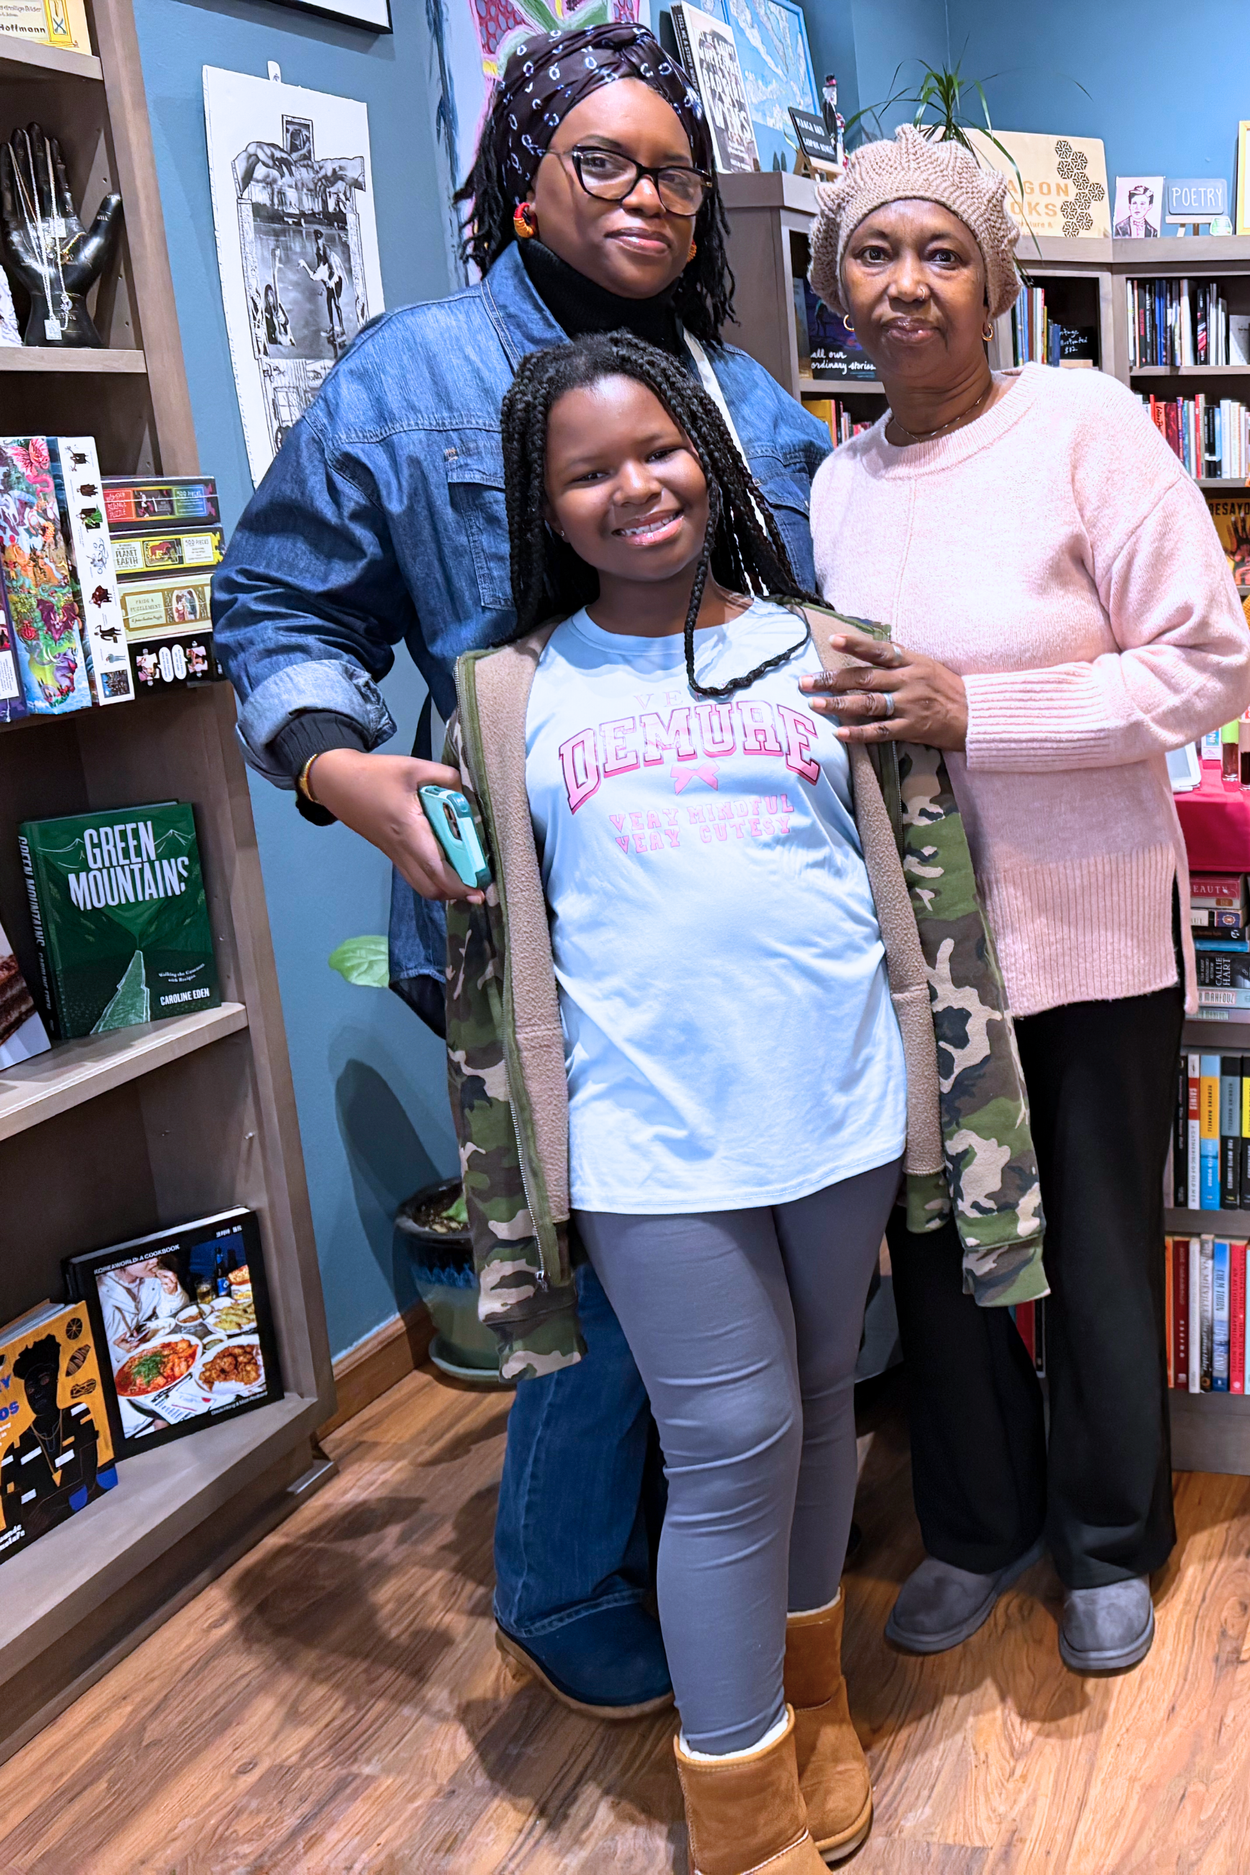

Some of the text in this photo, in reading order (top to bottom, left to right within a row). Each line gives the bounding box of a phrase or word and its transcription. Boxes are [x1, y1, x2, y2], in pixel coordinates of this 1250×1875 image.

[1007, 179, 1069, 197] AGON
[1172, 186, 1223, 207] POETRY
[1010, 201, 1057, 217] OKS
[559, 700, 822, 814] DEMURE
[609, 794, 794, 832] VERY MINDFUL
[83, 821, 156, 869] GREEN
[615, 816, 791, 854] VERY CUTESY
[68, 856, 190, 911] MOUNTAINS
[1222, 958, 1231, 986] HART
[160, 988, 210, 1006] CAROLINE EDEN
